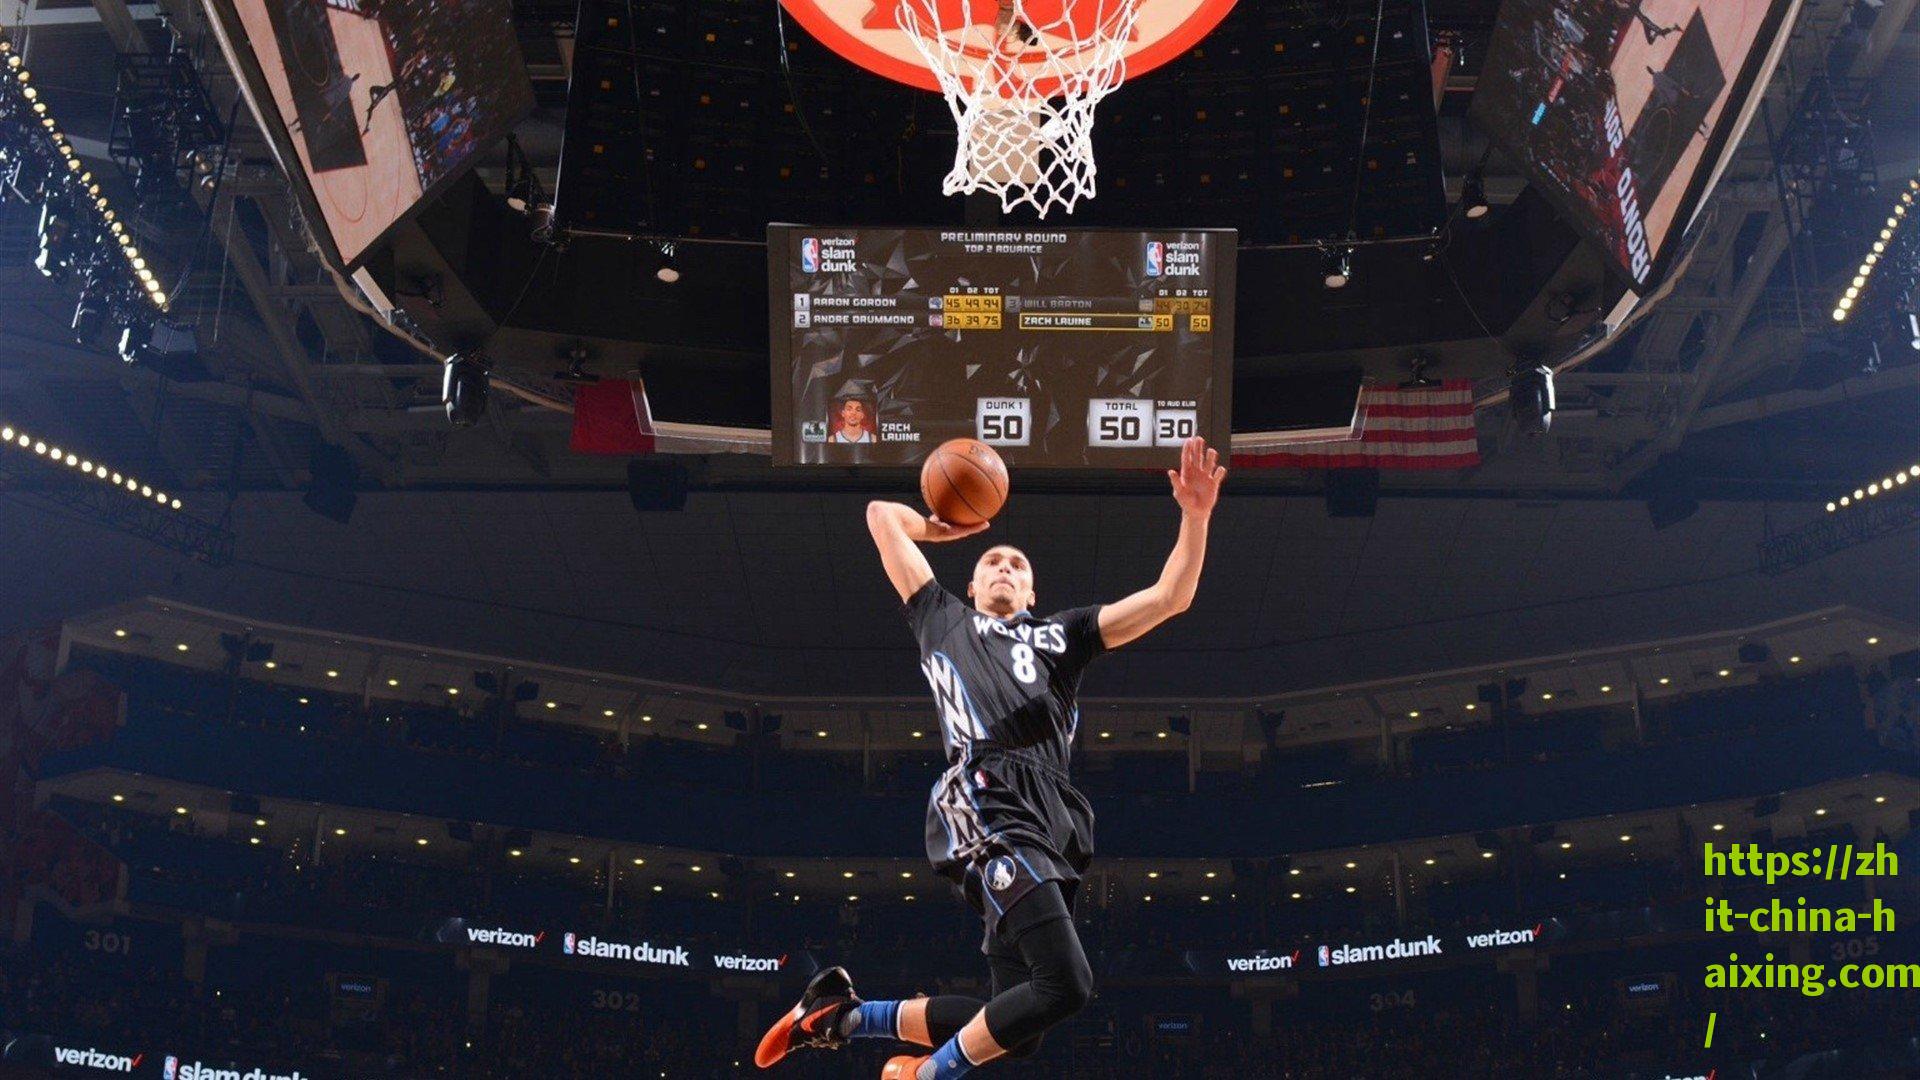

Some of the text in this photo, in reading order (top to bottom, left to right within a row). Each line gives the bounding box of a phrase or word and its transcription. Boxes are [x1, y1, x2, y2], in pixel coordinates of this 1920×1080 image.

[821, 238, 855, 246] verizon
[940, 232, 1022, 242] PRELIMINARY
[1025, 233, 1067, 243] ROUND
[965, 245, 984, 253] TOP
[986, 245, 992, 253] 2
[1166, 242, 1200, 250] verizon
[821, 247, 856, 259] slam
[1165, 250, 1200, 263] slam
[821, 260, 857, 272] dunk
[1165, 263, 1200, 276] dunk
[1192, 289, 1208, 297] TOT
[813, 298, 850, 307] AARON
[853, 298, 897, 307] GORDON
[946, 299, 961, 308] 45
[965, 299, 980, 308] 49
[984, 299, 999, 308] 94
[799, 315, 999, 325] 2 ANDRE DRUMMOND 36 39 75
[1024, 317, 1208, 327] ZACH LAVINE 50 50
[985, 401, 1015, 410] DUNK
[1105, 402, 1138, 411] TOTAL
[881, 423, 911, 432] ZACH
[983, 415, 1023, 440] 50
[1100, 416, 1140, 440] 50
[1160, 419, 1193, 438] 30
[881, 432, 921, 442] LAVINE
[1011, 643, 1037, 684] 8
[84, 930, 131, 954] 301
[467, 927, 536, 947] verizon
[1467, 927, 1534, 949] verizon
[576, 935, 690, 966] slam dunk
[1331, 935, 1442, 966] slam dunk
[714, 953, 779, 971] verizon
[1227, 953, 1292, 972] verizon
[340, 981, 372, 994] verizon
[1629, 983, 1659, 993] verizon
[592, 989, 640, 1012] 302
[55, 1046, 133, 1073] verizon
[178, 1061, 240, 1080] slam
